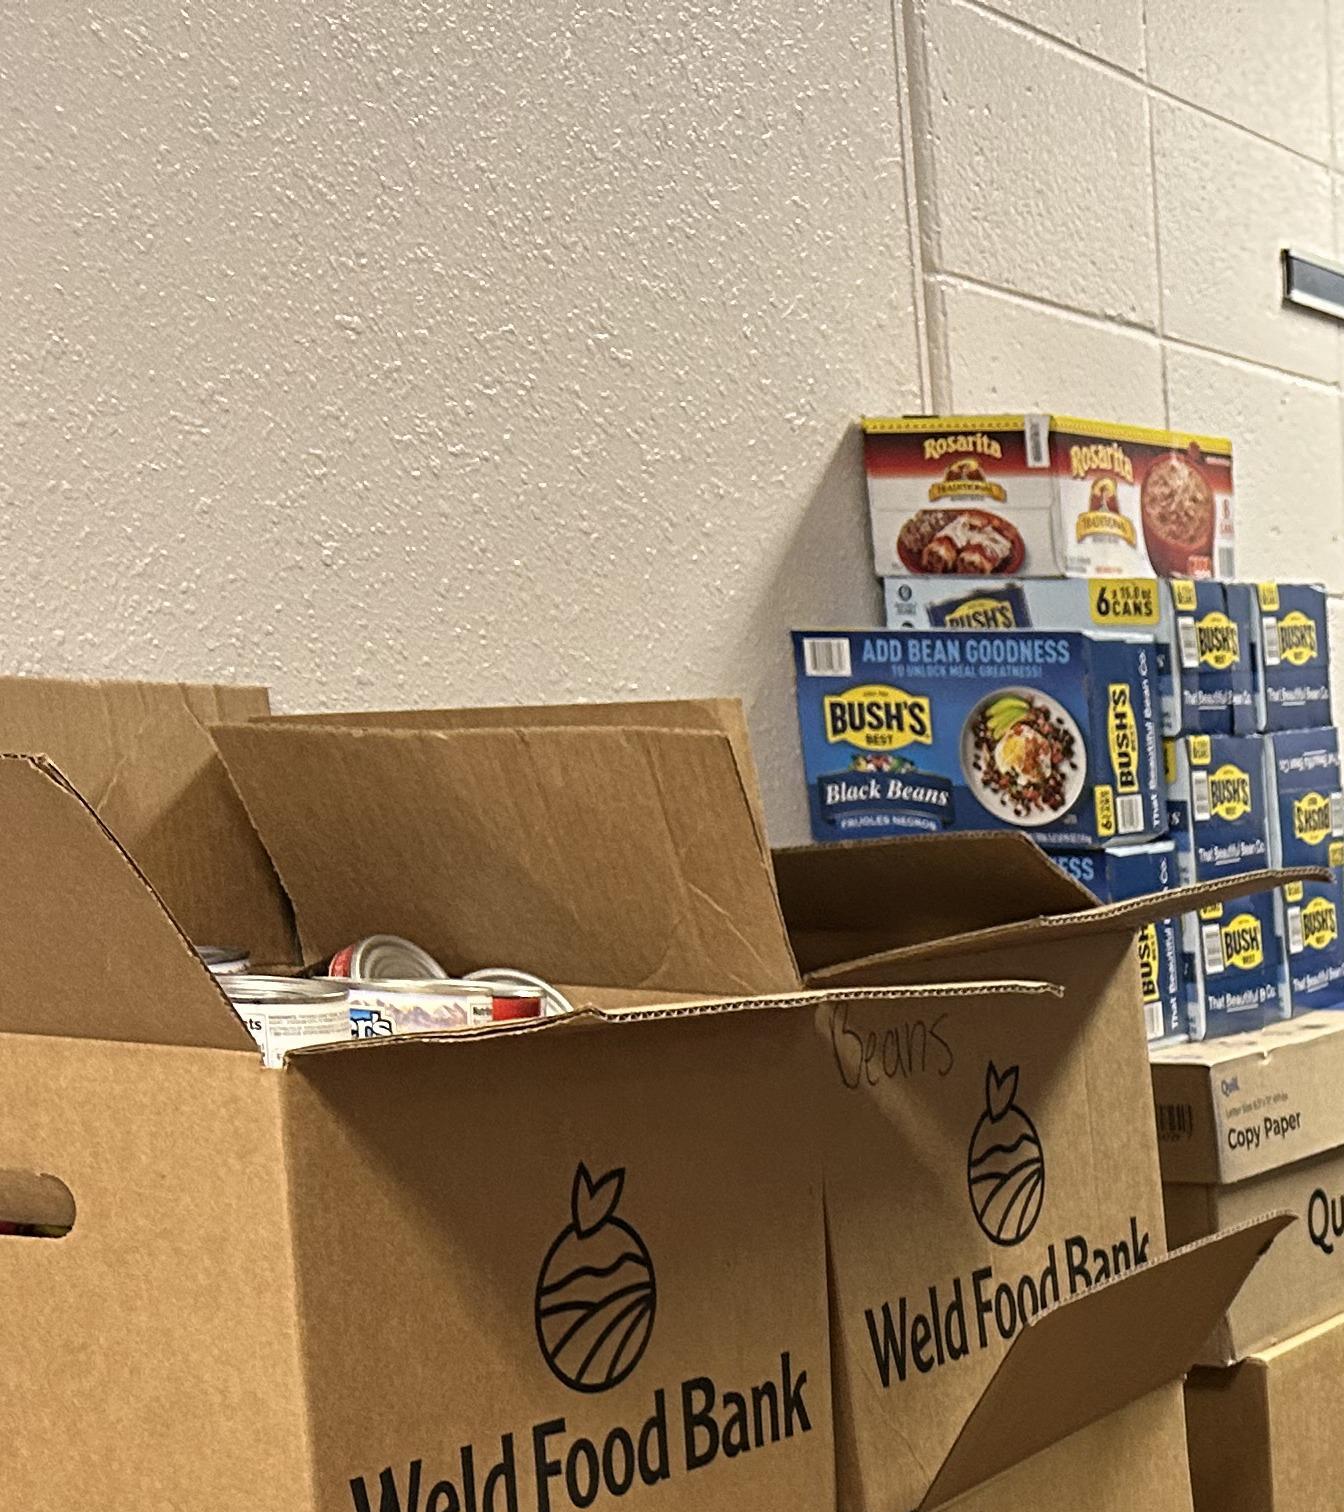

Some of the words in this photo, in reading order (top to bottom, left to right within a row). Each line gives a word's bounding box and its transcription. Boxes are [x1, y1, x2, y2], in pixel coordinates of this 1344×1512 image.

[923, 432, 1003, 460] Rosarita
[1070, 442, 1134, 485] Rosarita
[1096, 585, 1110, 617] 6
[1112, 600, 1153, 617] CANS
[862, 639, 900, 663] ADD
[907, 638, 960, 663] BEAN
[966, 639, 1070, 664] GOODNESS
[1142, 678, 1153, 719] Bean
[829, 700, 928, 737] BUSH'S
[865, 734, 893, 746] BEST
[1113, 689, 1136, 788] BUSH'S
[1145, 720, 1157, 791] Beautiful
[825, 779, 881, 806] Black
[886, 779, 950, 807] Beans
[1150, 793, 1160, 829] That
[1210, 777, 1249, 809] BUSH'S
[1303, 908, 1336, 941] BUSH'S
[1138, 921, 1155, 996] BUSH
[830, 1007, 955, 1090] Beans
[1227, 1123, 1261, 1151] Copy
[1263, 1111, 1301, 1140] Paper
[863, 1283, 967, 1390] Weld
[976, 1241, 1061, 1347] Food
[1066, 1216, 1151, 1297] Bank
[682, 1350, 814, 1472] Bank
